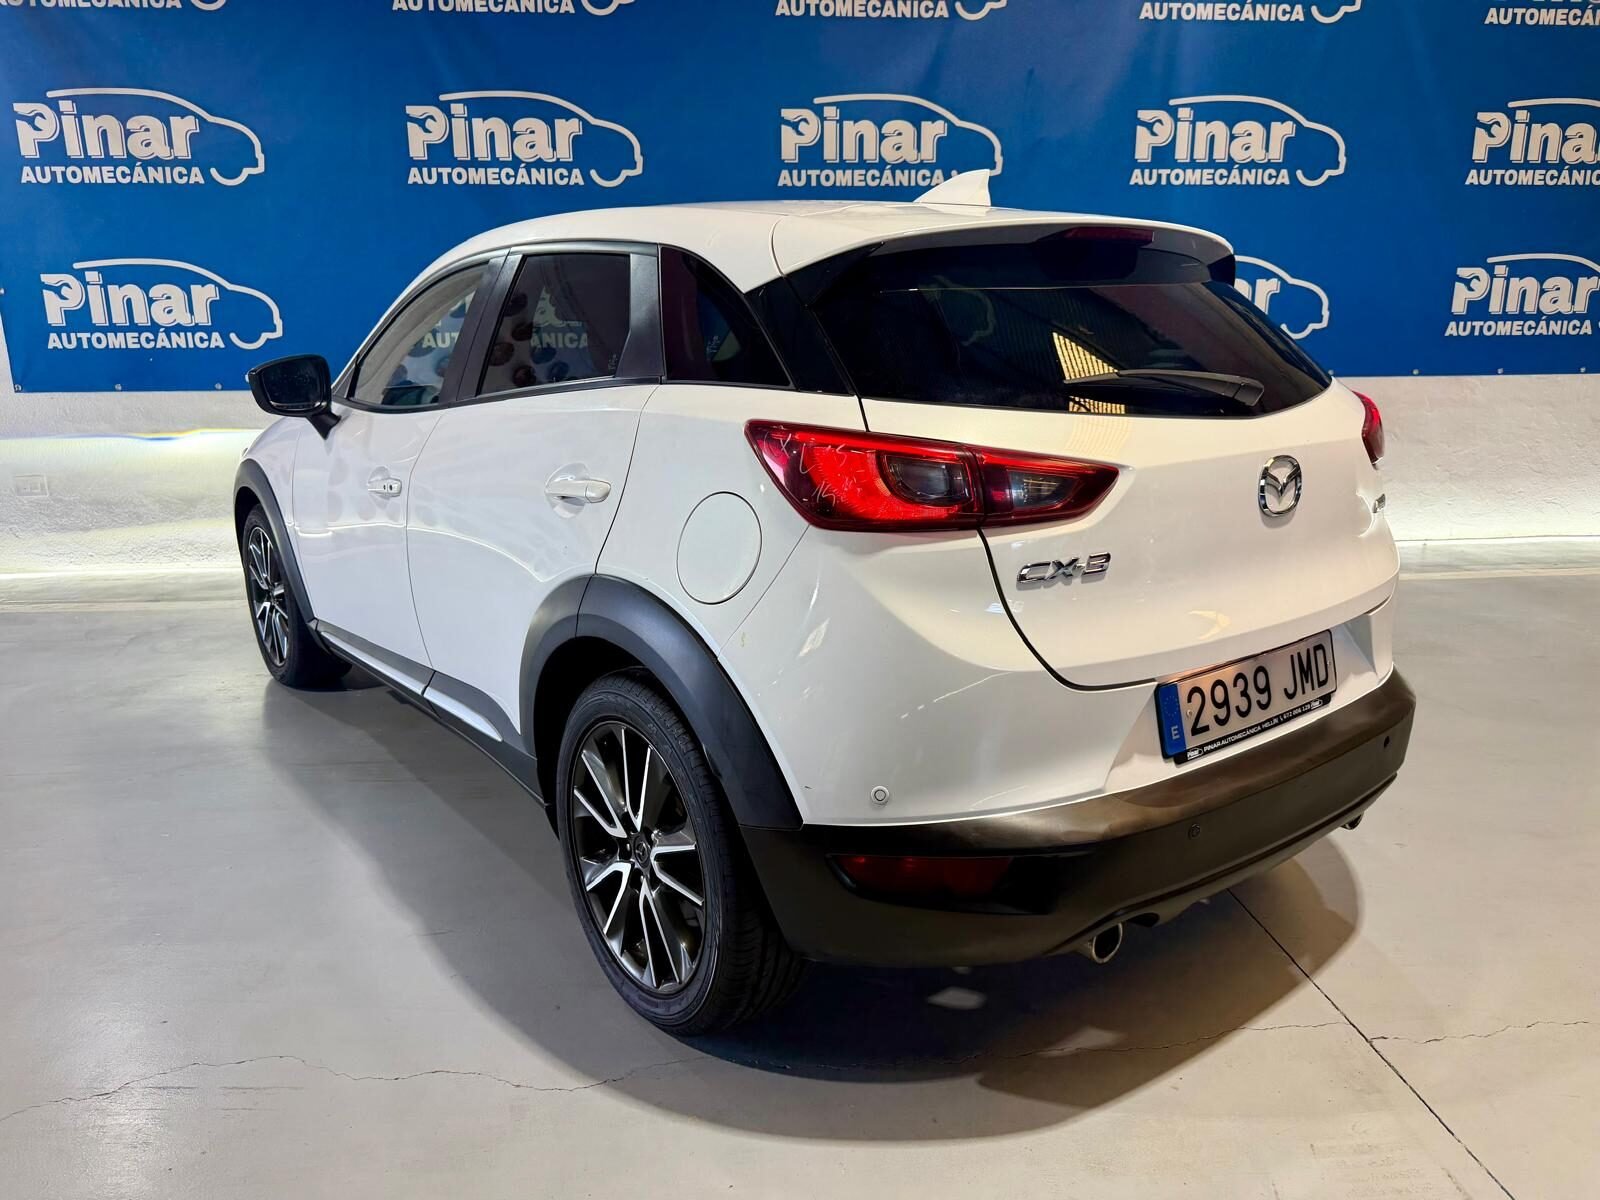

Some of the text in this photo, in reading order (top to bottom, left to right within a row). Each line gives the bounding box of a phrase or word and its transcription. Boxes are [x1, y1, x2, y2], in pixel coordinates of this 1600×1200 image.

[1484, 5, 1600, 26] AUTOMECÁ
[13, 101, 200, 160] Pinar
[406, 103, 583, 162] Pinar
[781, 106, 947, 164] Pinar
[1134, 107, 1296, 163] Pinar
[1472, 110, 1600, 165] Pina
[21, 162, 205, 184] AUTOMECÁNICA
[408, 163, 584, 185] AUTOMECÁNICA
[777, 165, 945, 187] AUTOMECÁNICA
[1129, 165, 1290, 186] AUTOMECÁNICA
[40, 271, 220, 327] Pinar
[1451, 265, 1600, 315] Pinar
[48, 329, 226, 349] AUTOMECÁNICA
[1444, 315, 1593, 337] AUTOMECÁNICA
[1017, 551, 1112, 584] CX-3
[1186, 643, 1330, 737] 2939 JMD
[1171, 725, 1181, 740] E
